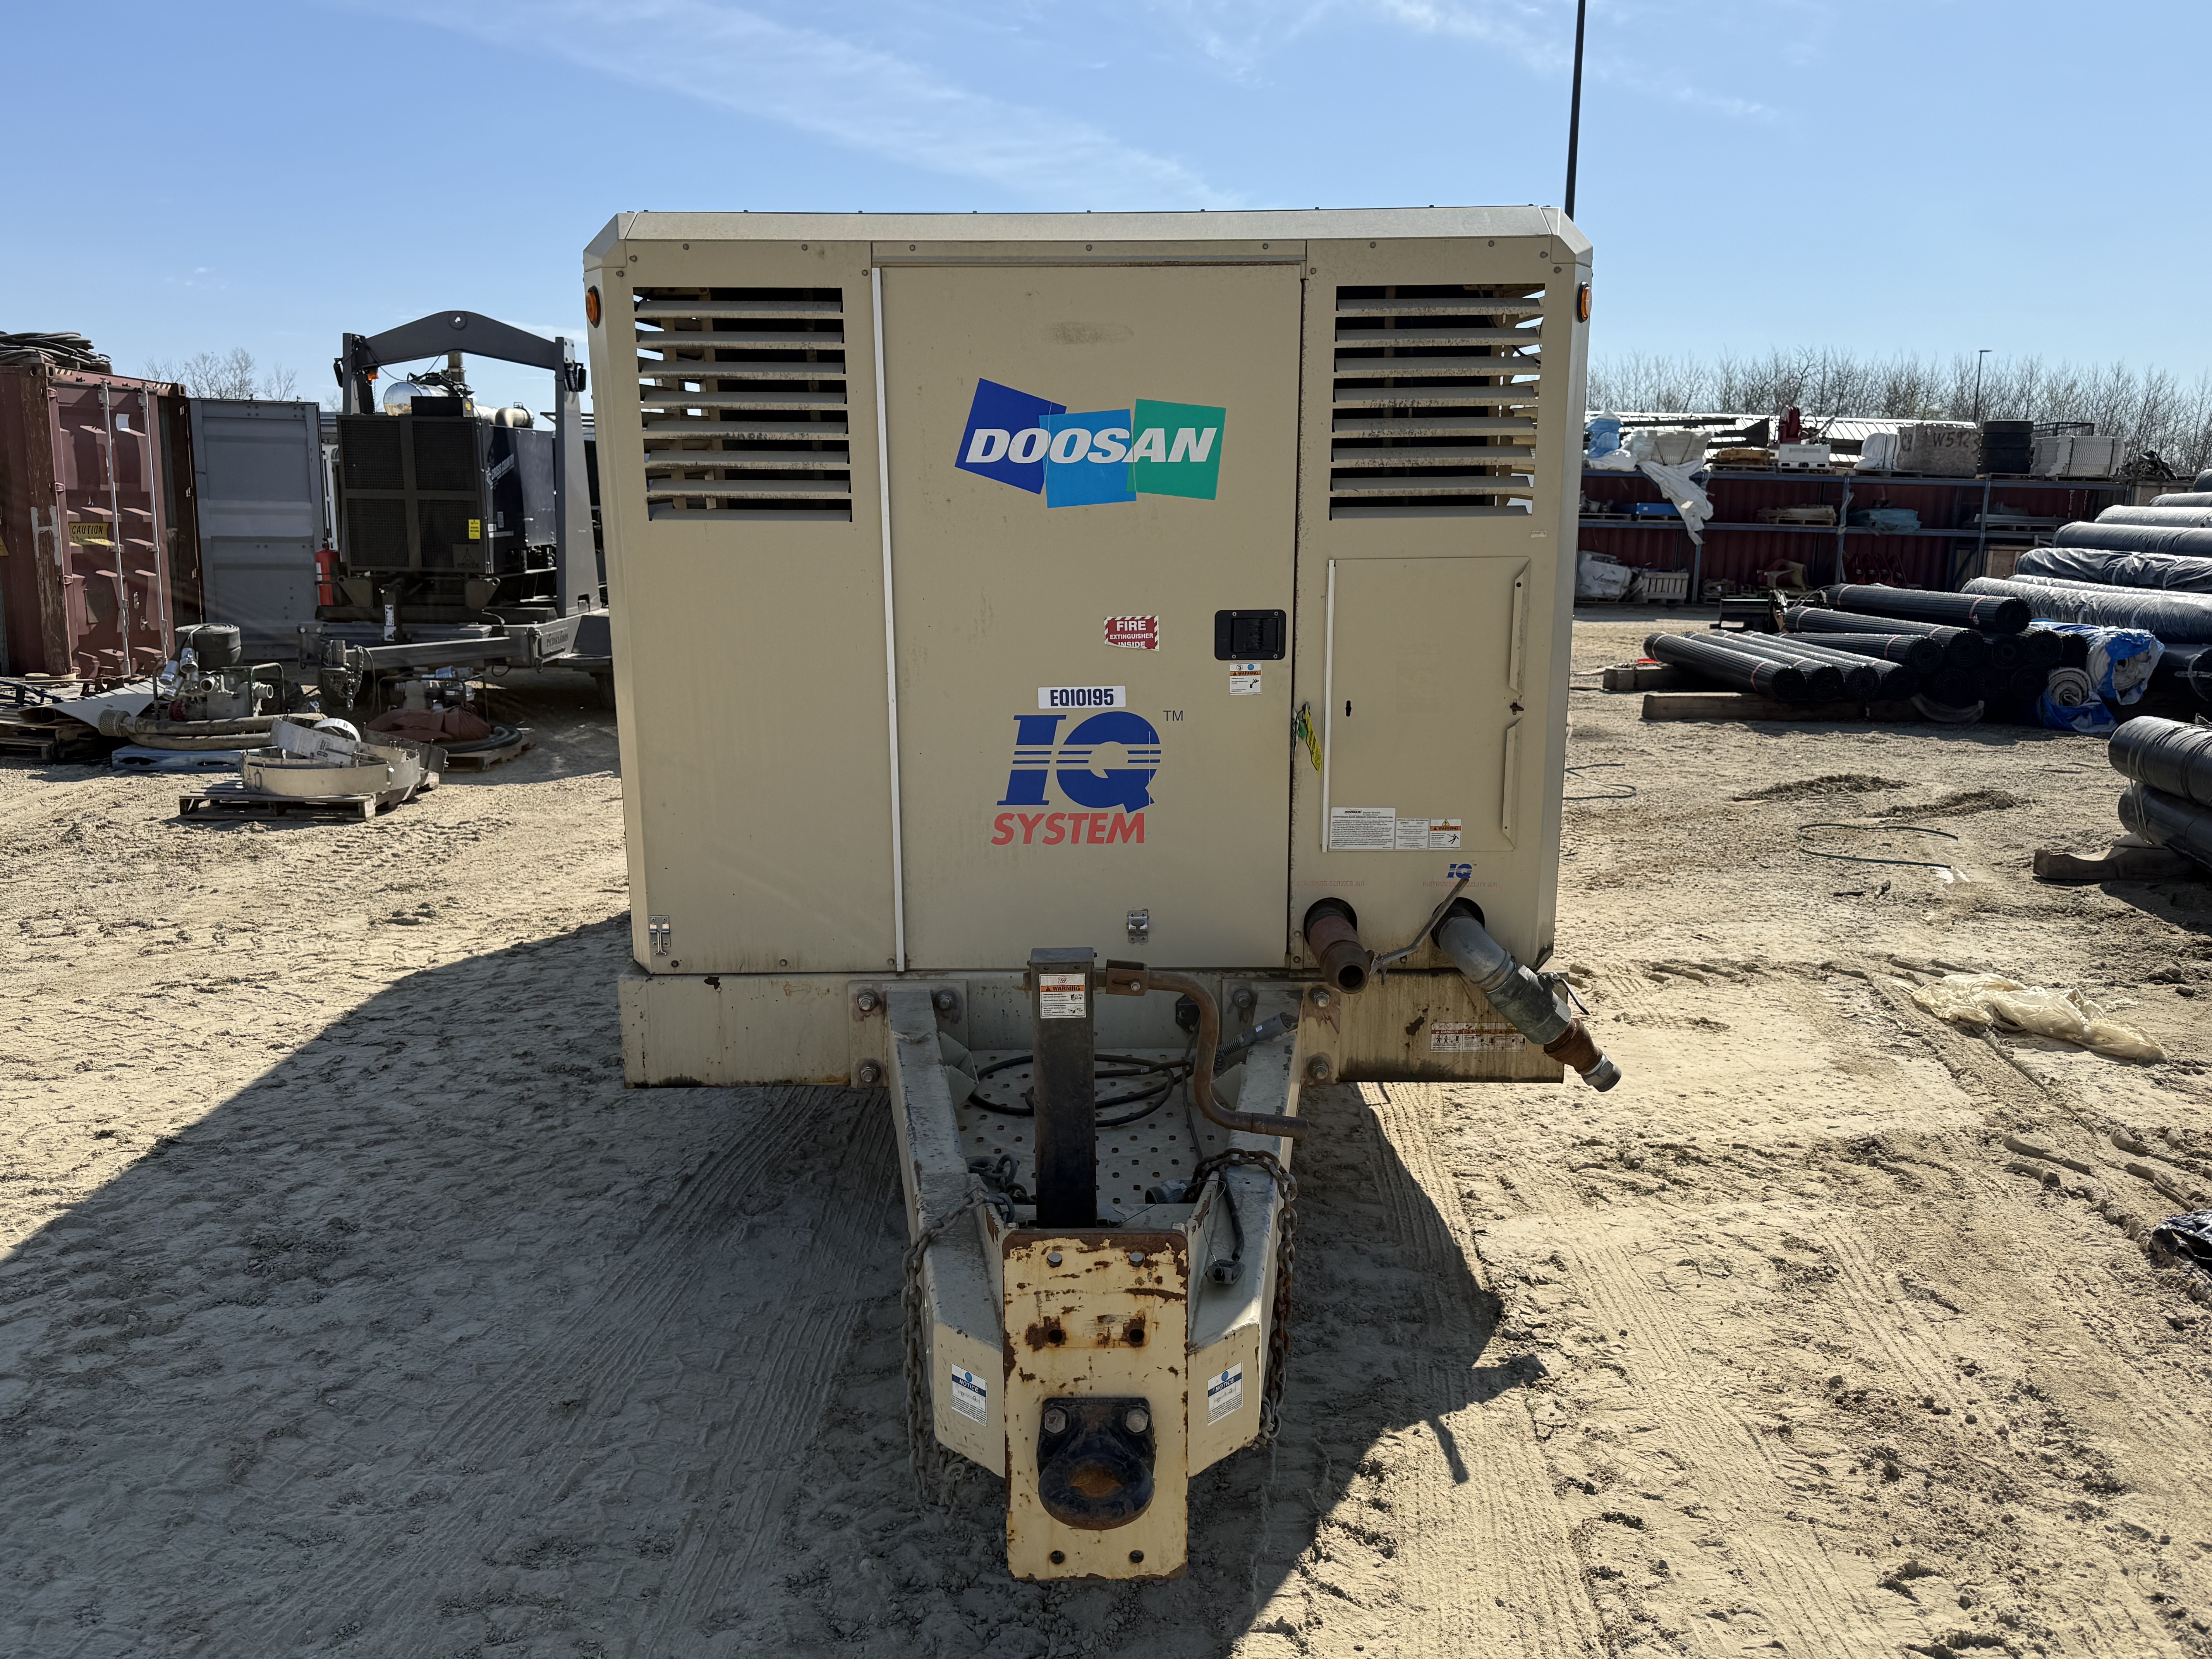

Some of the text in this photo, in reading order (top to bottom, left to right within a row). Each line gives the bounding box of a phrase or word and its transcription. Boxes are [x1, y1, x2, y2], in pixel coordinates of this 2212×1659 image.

[965, 428, 1218, 464] DOOSAN
[72, 526, 103, 534] CAUTION
[1116, 620, 1147, 631] FIRE
[1050, 689, 1114, 706] EQ10195
[996, 710, 1183, 814] IQ TM
[991, 812, 1145, 846] SYSTEM
[1446, 864, 1473, 879] IQ
[959, 1379, 979, 1393] NOTICE
[1215, 1377, 1235, 1392] NOTICE
